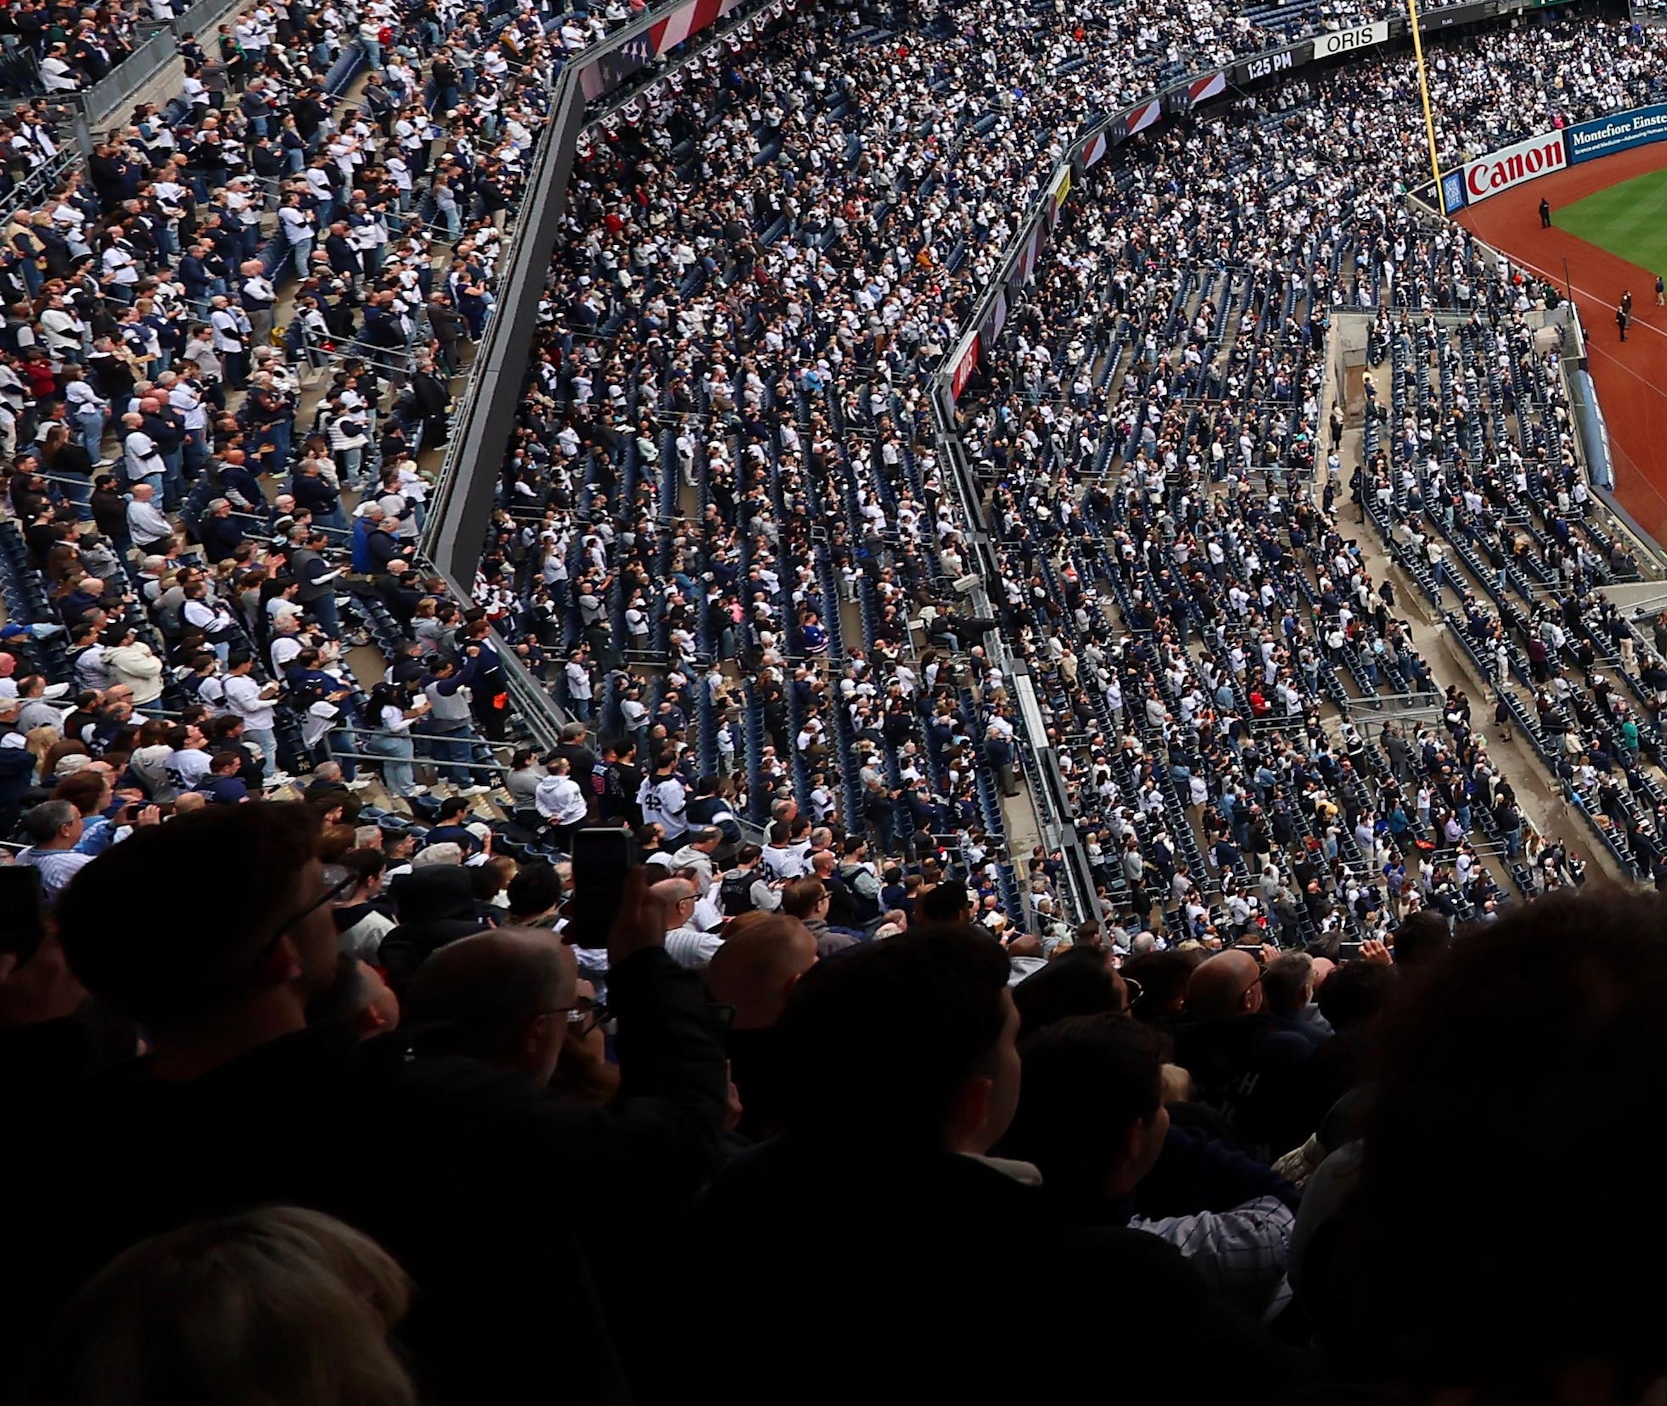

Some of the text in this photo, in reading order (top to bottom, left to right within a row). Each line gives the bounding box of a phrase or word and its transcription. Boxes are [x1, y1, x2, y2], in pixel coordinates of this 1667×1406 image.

[1327, 28, 1373, 52] ORIS
[1247, 51, 1293, 80] 1:25 PM
[1572, 123, 1631, 146] Montefiore
[1467, 140, 1564, 196] Canon
